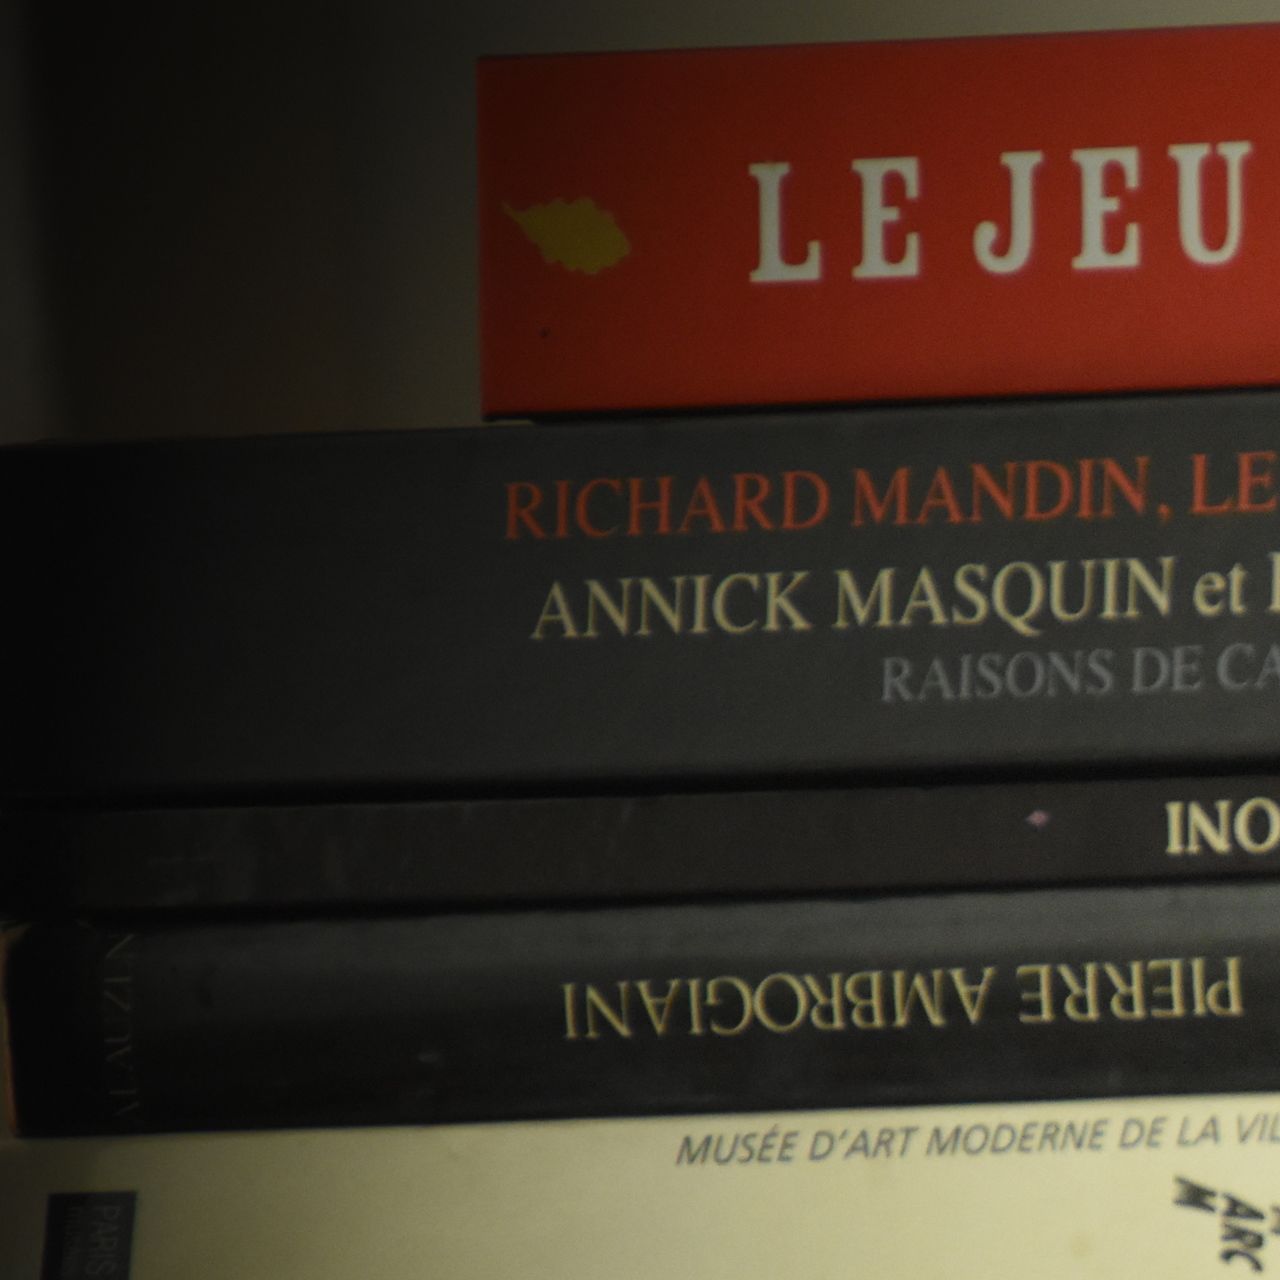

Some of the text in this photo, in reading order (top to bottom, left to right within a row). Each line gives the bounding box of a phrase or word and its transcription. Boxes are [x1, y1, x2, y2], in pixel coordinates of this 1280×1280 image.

[748, 157, 921, 282] LE
[973, 142, 1251, 275] JEU
[504, 470, 829, 540] RICHARD
[851, 455, 1171, 528] MANDIN,
[1189, 451, 1279, 516] LE
[531, 571, 811, 640] ANNICK
[830, 556, 1177, 637] MASQUIN
[1194, 564, 1245, 617] et
[880, 649, 1114, 705] RAISONS
[1131, 644, 1202, 694] DE
[562, 956, 1245, 1041] PIERRE AMBROGIANI
[674, 1124, 798, 1167] MUSÉE
[808, 1125, 921, 1162] D'ART
[925, 1116, 1110, 1157] MODERNE
[1117, 1114, 1165, 1150] DE
[1176, 1111, 1223, 1147] LA
